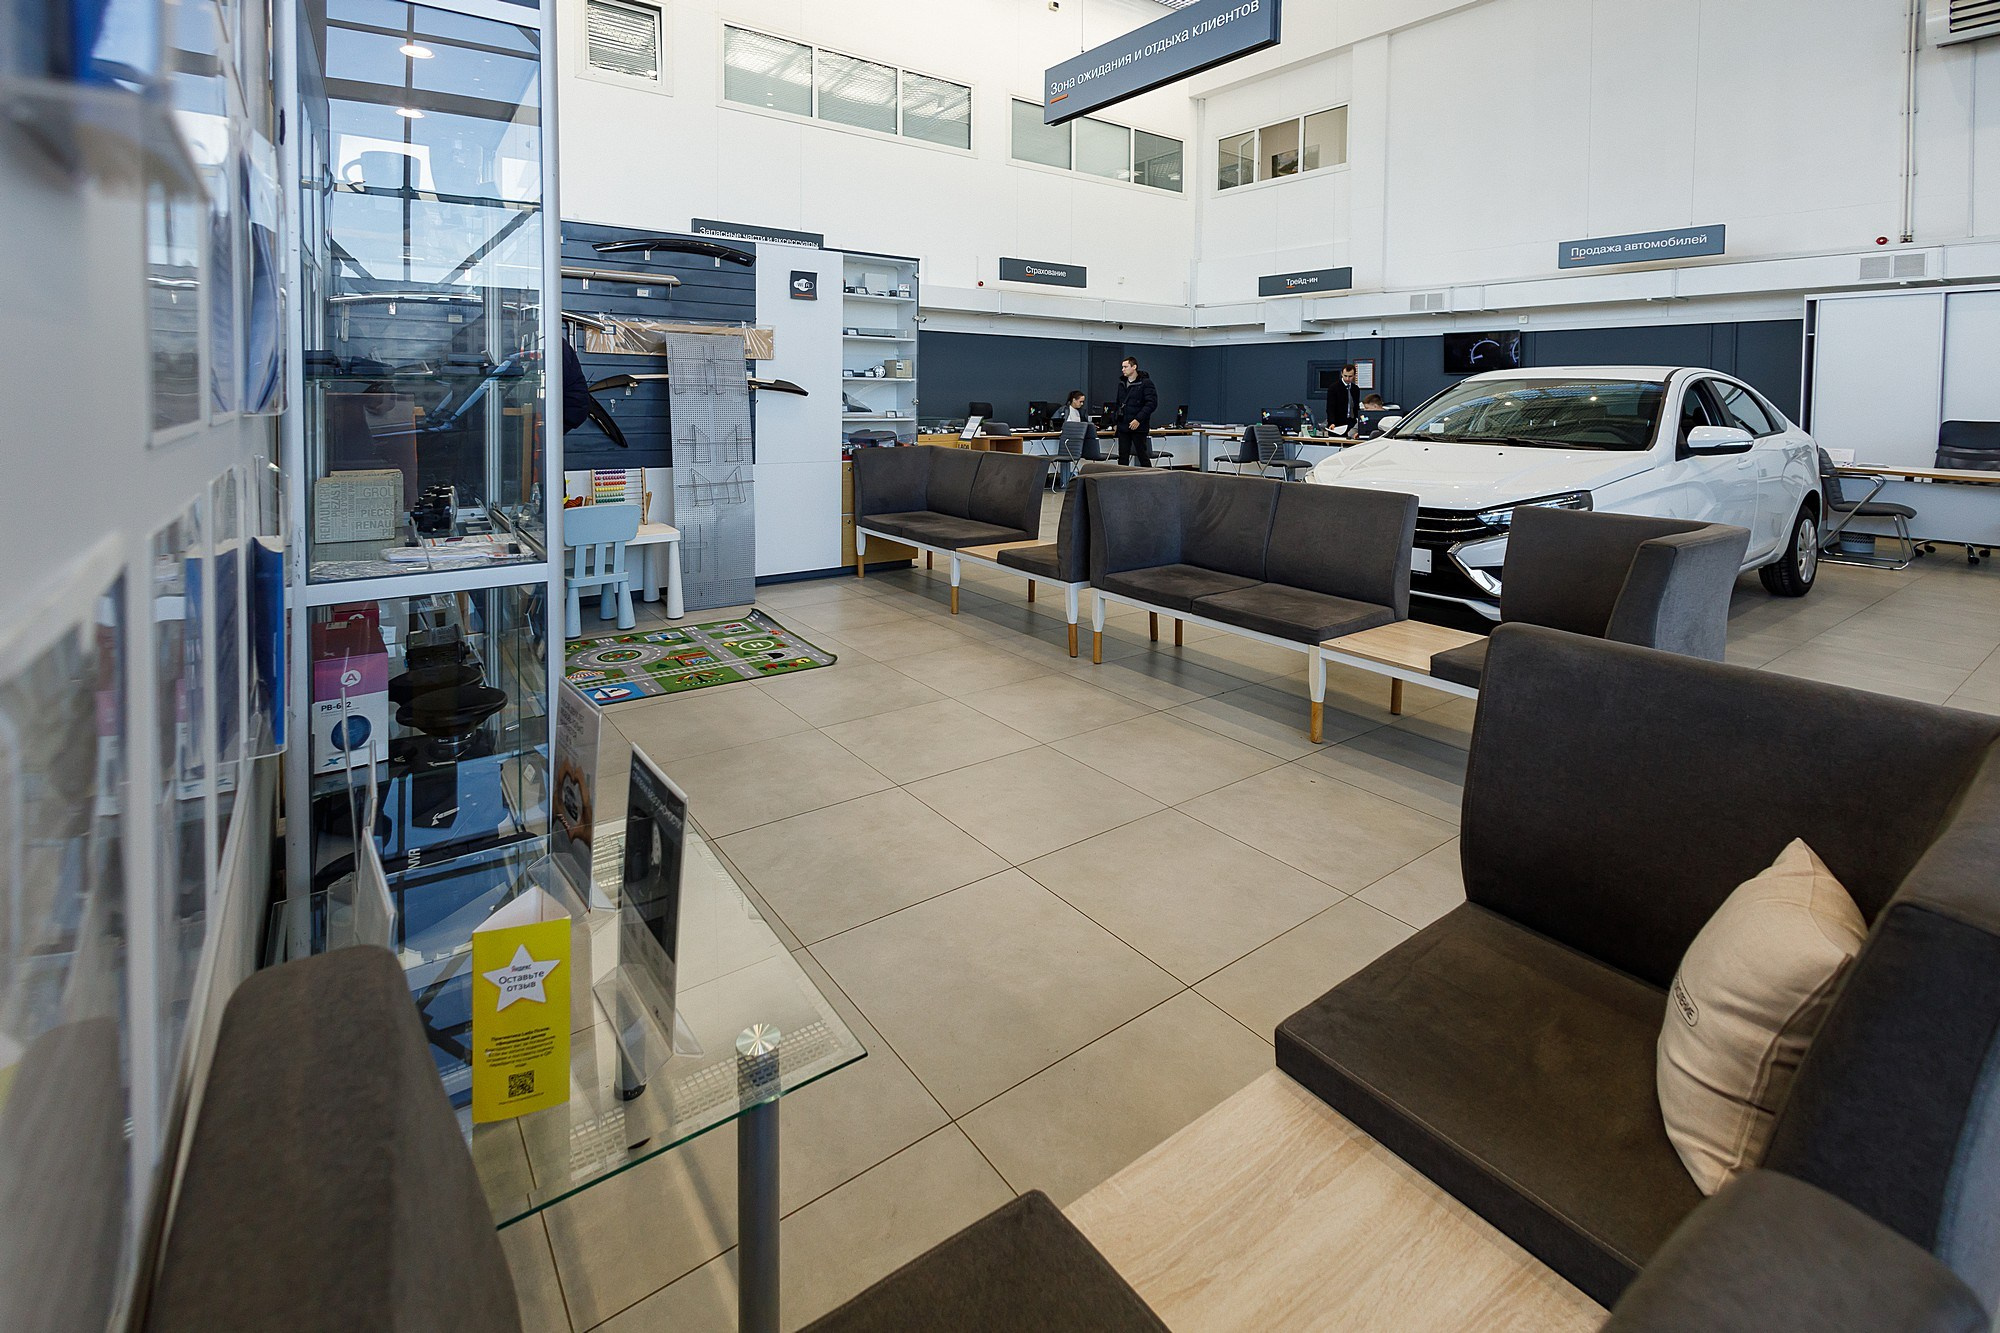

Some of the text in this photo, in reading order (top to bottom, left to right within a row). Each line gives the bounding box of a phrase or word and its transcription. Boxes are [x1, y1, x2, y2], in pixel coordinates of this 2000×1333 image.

[1050, 0, 1260, 96] Зона ожидания и отдыха клиентов
[699, 226, 741, 238] Запасные
[1571, 234, 1708, 257] Продажа автомобилей
[1025, 265, 1067, 278] Страхование
[1286, 277, 1318, 287] Трейд-ин
[321, 701, 352, 712] PB-62
[498, 970, 545, 985] Оставьте
[506, 981, 537, 992] отзыв
